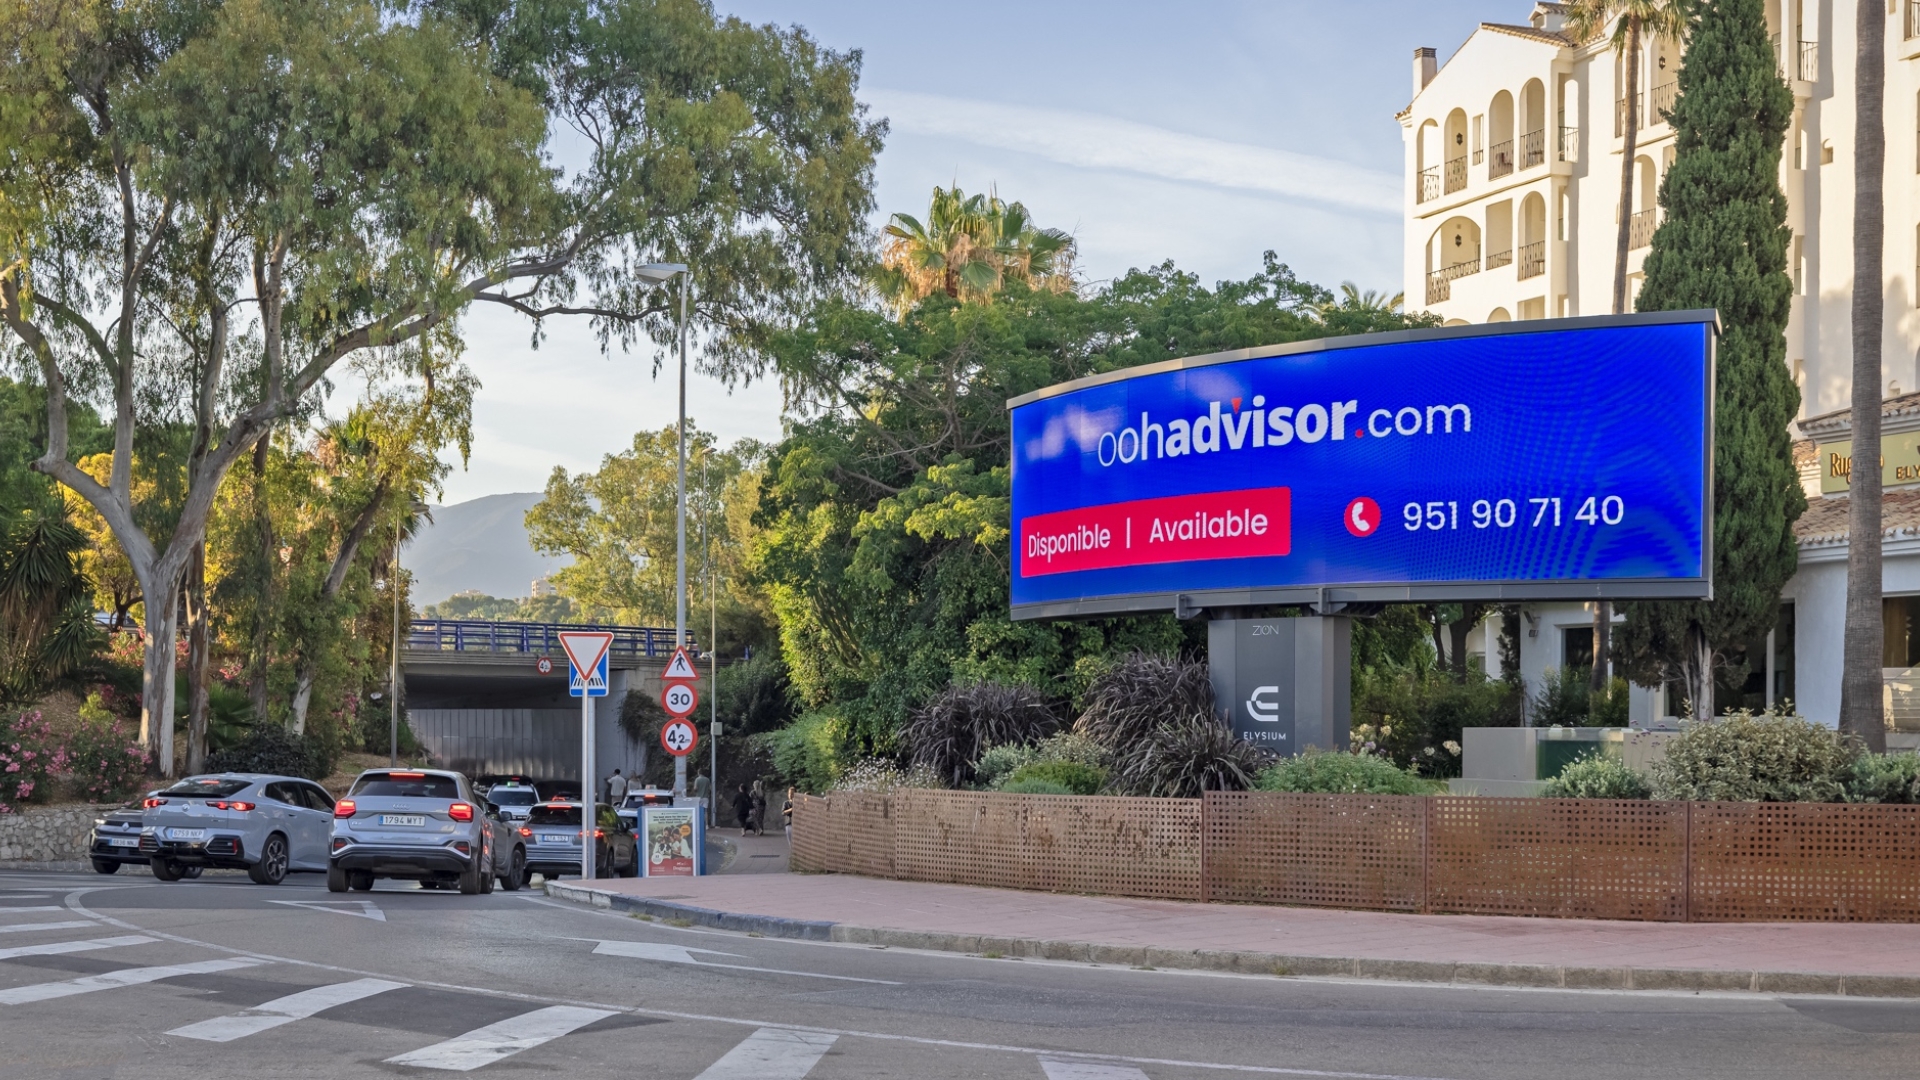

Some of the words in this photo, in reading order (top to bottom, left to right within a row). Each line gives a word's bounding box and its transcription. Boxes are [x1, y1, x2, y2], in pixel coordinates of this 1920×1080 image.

[1098, 395, 1471, 467] oohadvisor.com
[1403, 502, 1457, 531] 951
[1472, 499, 1516, 529] 90
[1529, 498, 1561, 527] 71
[1575, 495, 1624, 526] 40
[1028, 522, 1111, 563] Disponible
[1149, 508, 1269, 544] Available
[1252, 625, 1279, 636] ZION
[670, 693, 690, 706] 30
[1243, 731, 1287, 740] ELYSIUM
[385, 815, 404, 824] 1794
[407, 816, 423, 825] MYT
